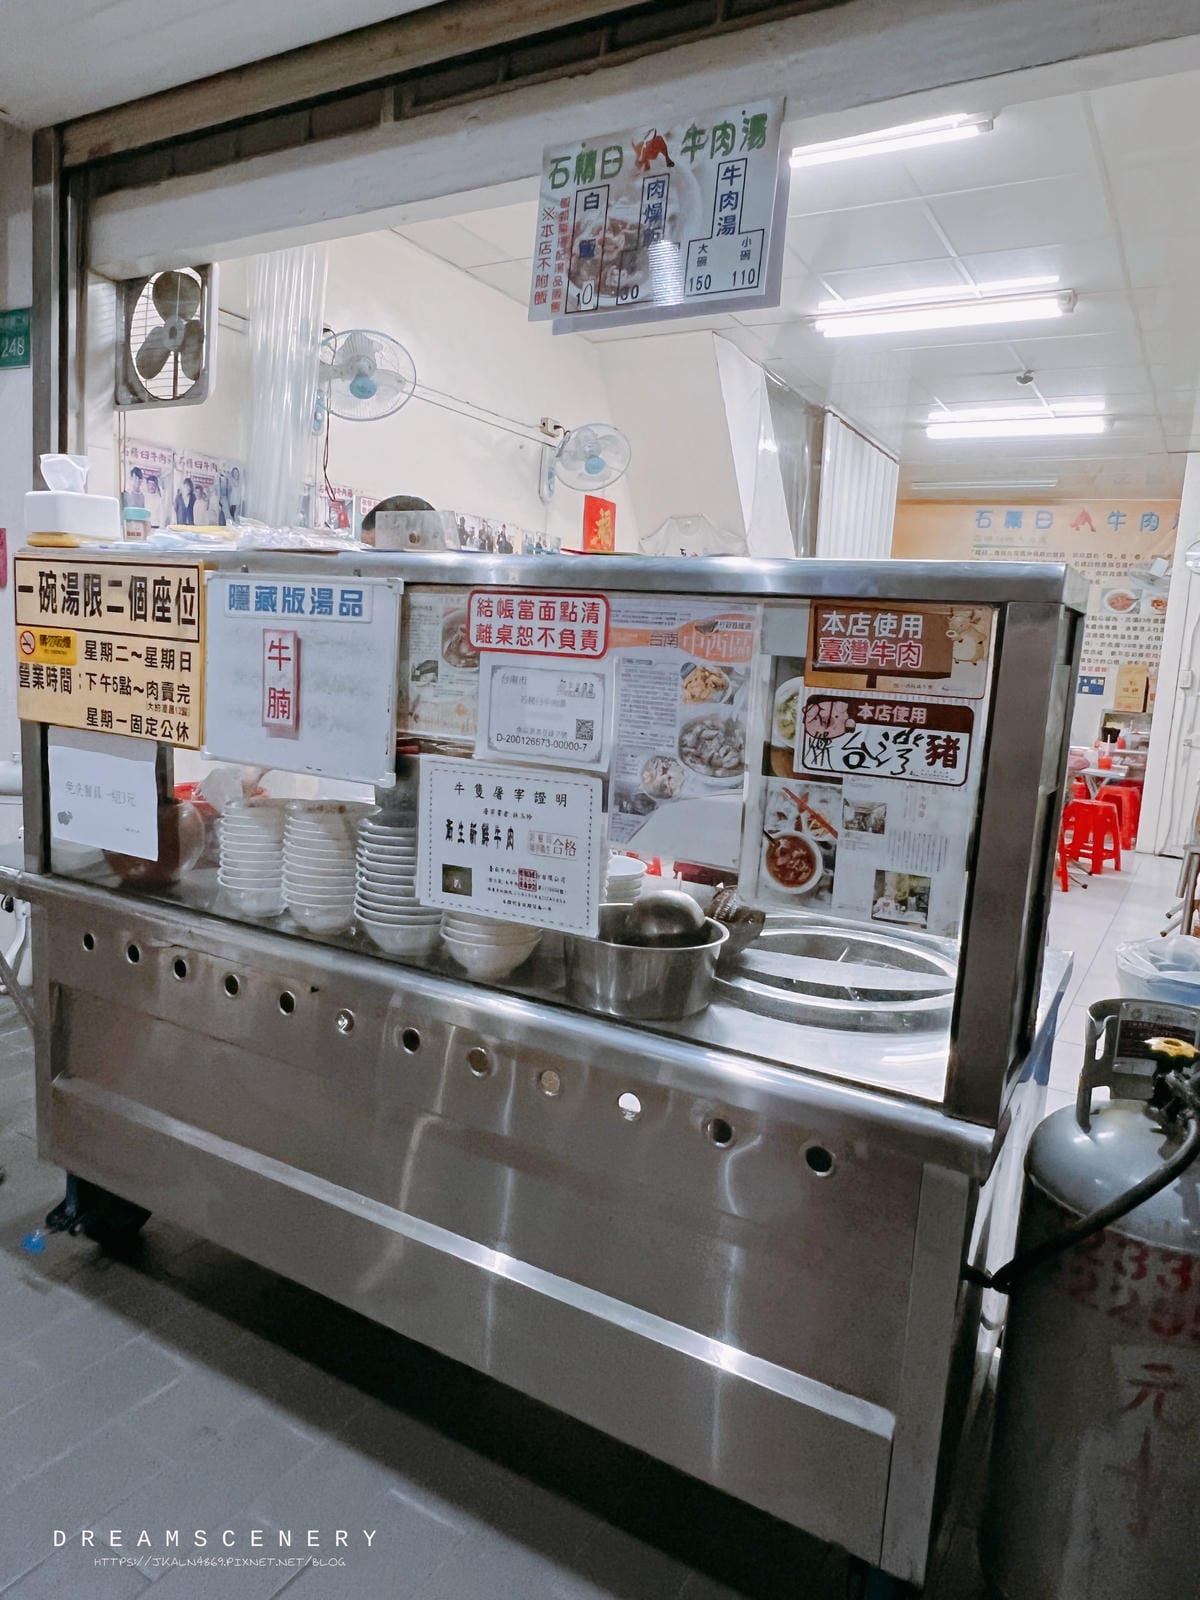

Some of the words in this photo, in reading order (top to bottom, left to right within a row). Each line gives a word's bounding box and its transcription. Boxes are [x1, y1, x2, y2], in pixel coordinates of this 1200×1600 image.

[680, 110, 768, 164] 牛肉湯
[716, 164, 742, 237] 牛肉湯
[689, 274, 712, 292] 150
[732, 268, 756, 288] 110
[576, 283, 593, 307] 10
[1107, 509, 1179, 532] 牛肉
[18, 570, 197, 626] 一碗湯限二個座位
[228, 583, 364, 618] 隱藏版湯品
[477, 597, 601, 625] 結帳當面點清
[475, 623, 599, 652] 離桌恕不負責
[821, 610, 923, 639] 本店使用
[819, 636, 923, 669] 臺灣牛肉
[266, 640, 291, 721] 牛腩
[86, 707, 190, 743] 星期一固定公休
[857, 702, 928, 725] 本店使用
[454, 781, 568, 808] 牛隻屠宰證明
[552, 837, 577, 857] 合格
